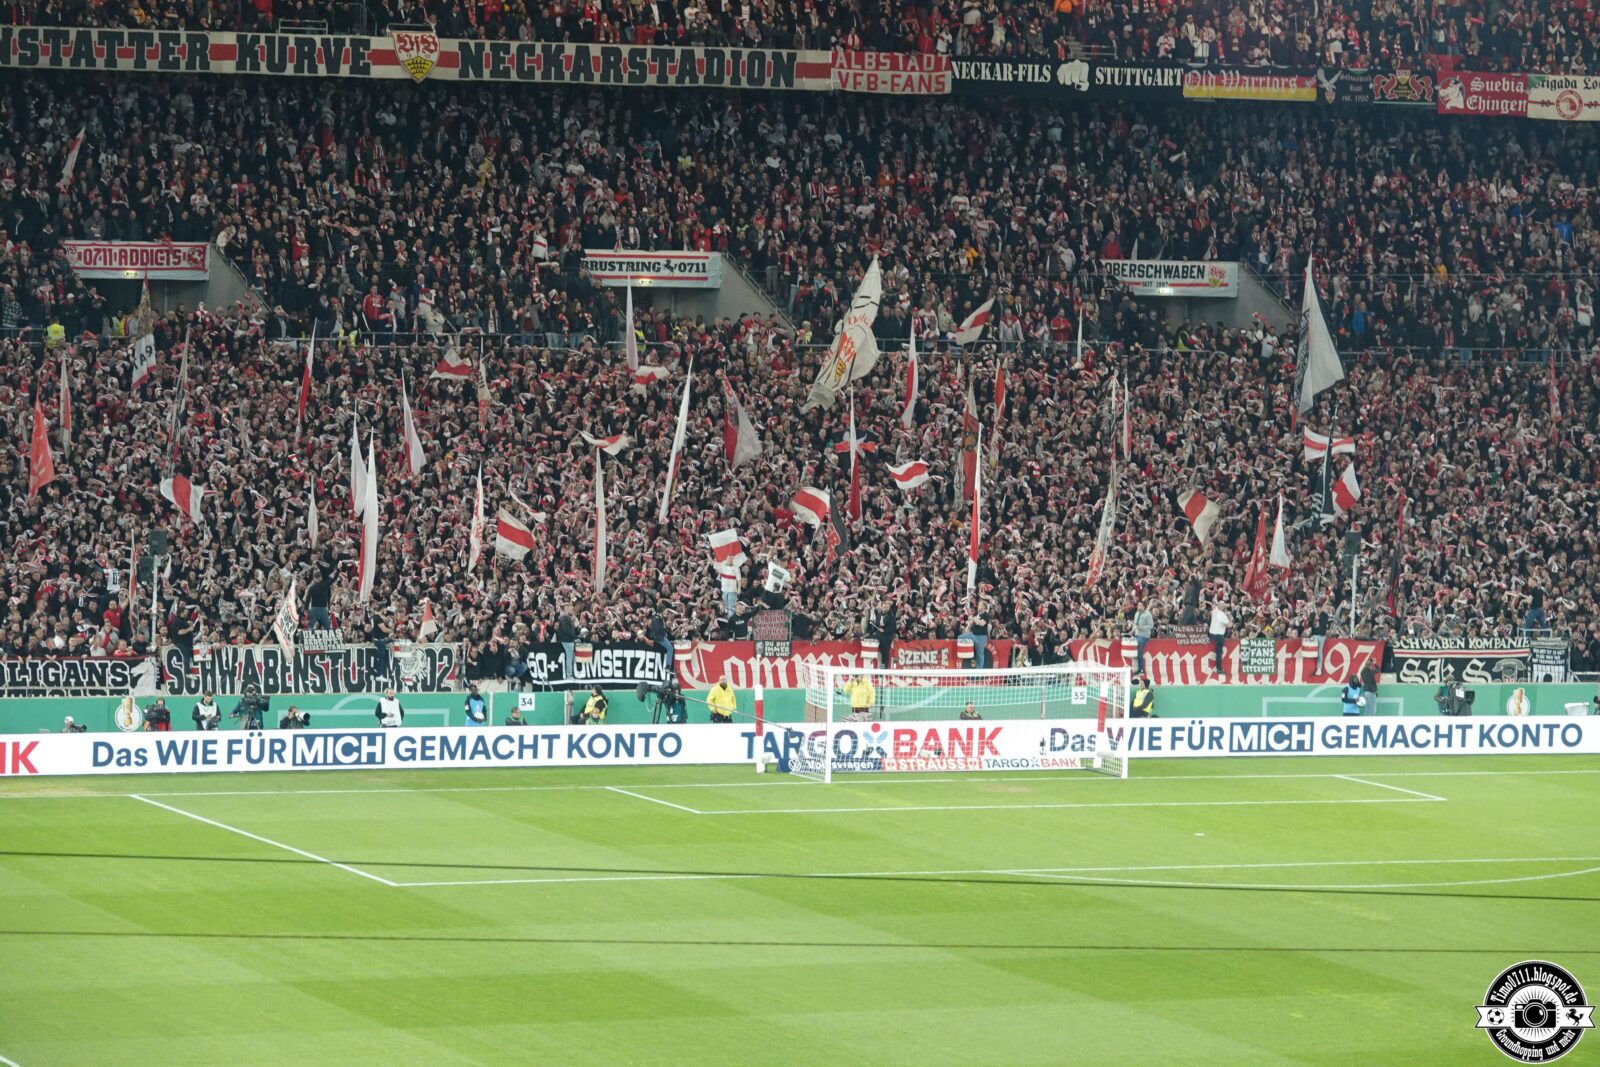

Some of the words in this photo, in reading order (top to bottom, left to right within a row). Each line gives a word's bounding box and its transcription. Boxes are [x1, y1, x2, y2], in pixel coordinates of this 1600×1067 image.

[235, 33, 371, 76] KURVE
[834, 52, 949, 71] ALBSTADT
[458, 41, 798, 88] NECKARSTADION
[951, 60, 1052, 83] NECKAR-FILS
[1095, 66, 1184, 87] STUTTGART
[837, 70, 946, 93] VFB-FANS
[1184, 69, 1217, 91] Old
[1470, 77, 1525, 93] Suebia
[1583, 77, 1600, 90] Lo
[83, 247, 113, 266] 0711
[118, 247, 182, 267] ADDICTS
[678, 262, 707, 274] 0711
[1106, 262, 1206, 280] OBERSCHWABEN
[302, 629, 343, 640] ULTRAS
[1250, 639, 1276, 648] MAGIC
[1392, 637, 1466, 650] SCHWABEN
[1468, 636, 1530, 651] KOMPANIE
[898, 647, 939, 666] SZENE
[941, 647, 949, 666] E
[1250, 647, 1275, 658] FANS
[1250, 657, 1275, 666] POUR
[1324, 641, 1376, 684] 97
[0, 659, 130, 687] LIGANS
[520, 697, 533, 707] 34
[1073, 691, 1085, 700] 35
[1050, 727, 1097, 753] Das
[1105, 726, 1162, 751] WIE
[1170, 719, 1225, 750] FÜR
[1231, 723, 1313, 751] MICH
[1320, 723, 1473, 749] GEMACHT
[1478, 722, 1583, 748] KONTO
[0, 740, 40, 775] K
[92, 741, 148, 767] Das
[155, 739, 218, 766] WIE
[226, 732, 287, 765] FÜR
[294, 735, 384, 764] MICH
[393, 733, 560, 761] GEMACHT
[566, 731, 682, 759] KONTO
[808, 761, 874, 772] Volswagen
[899, 757, 967, 771] STRAUSS
